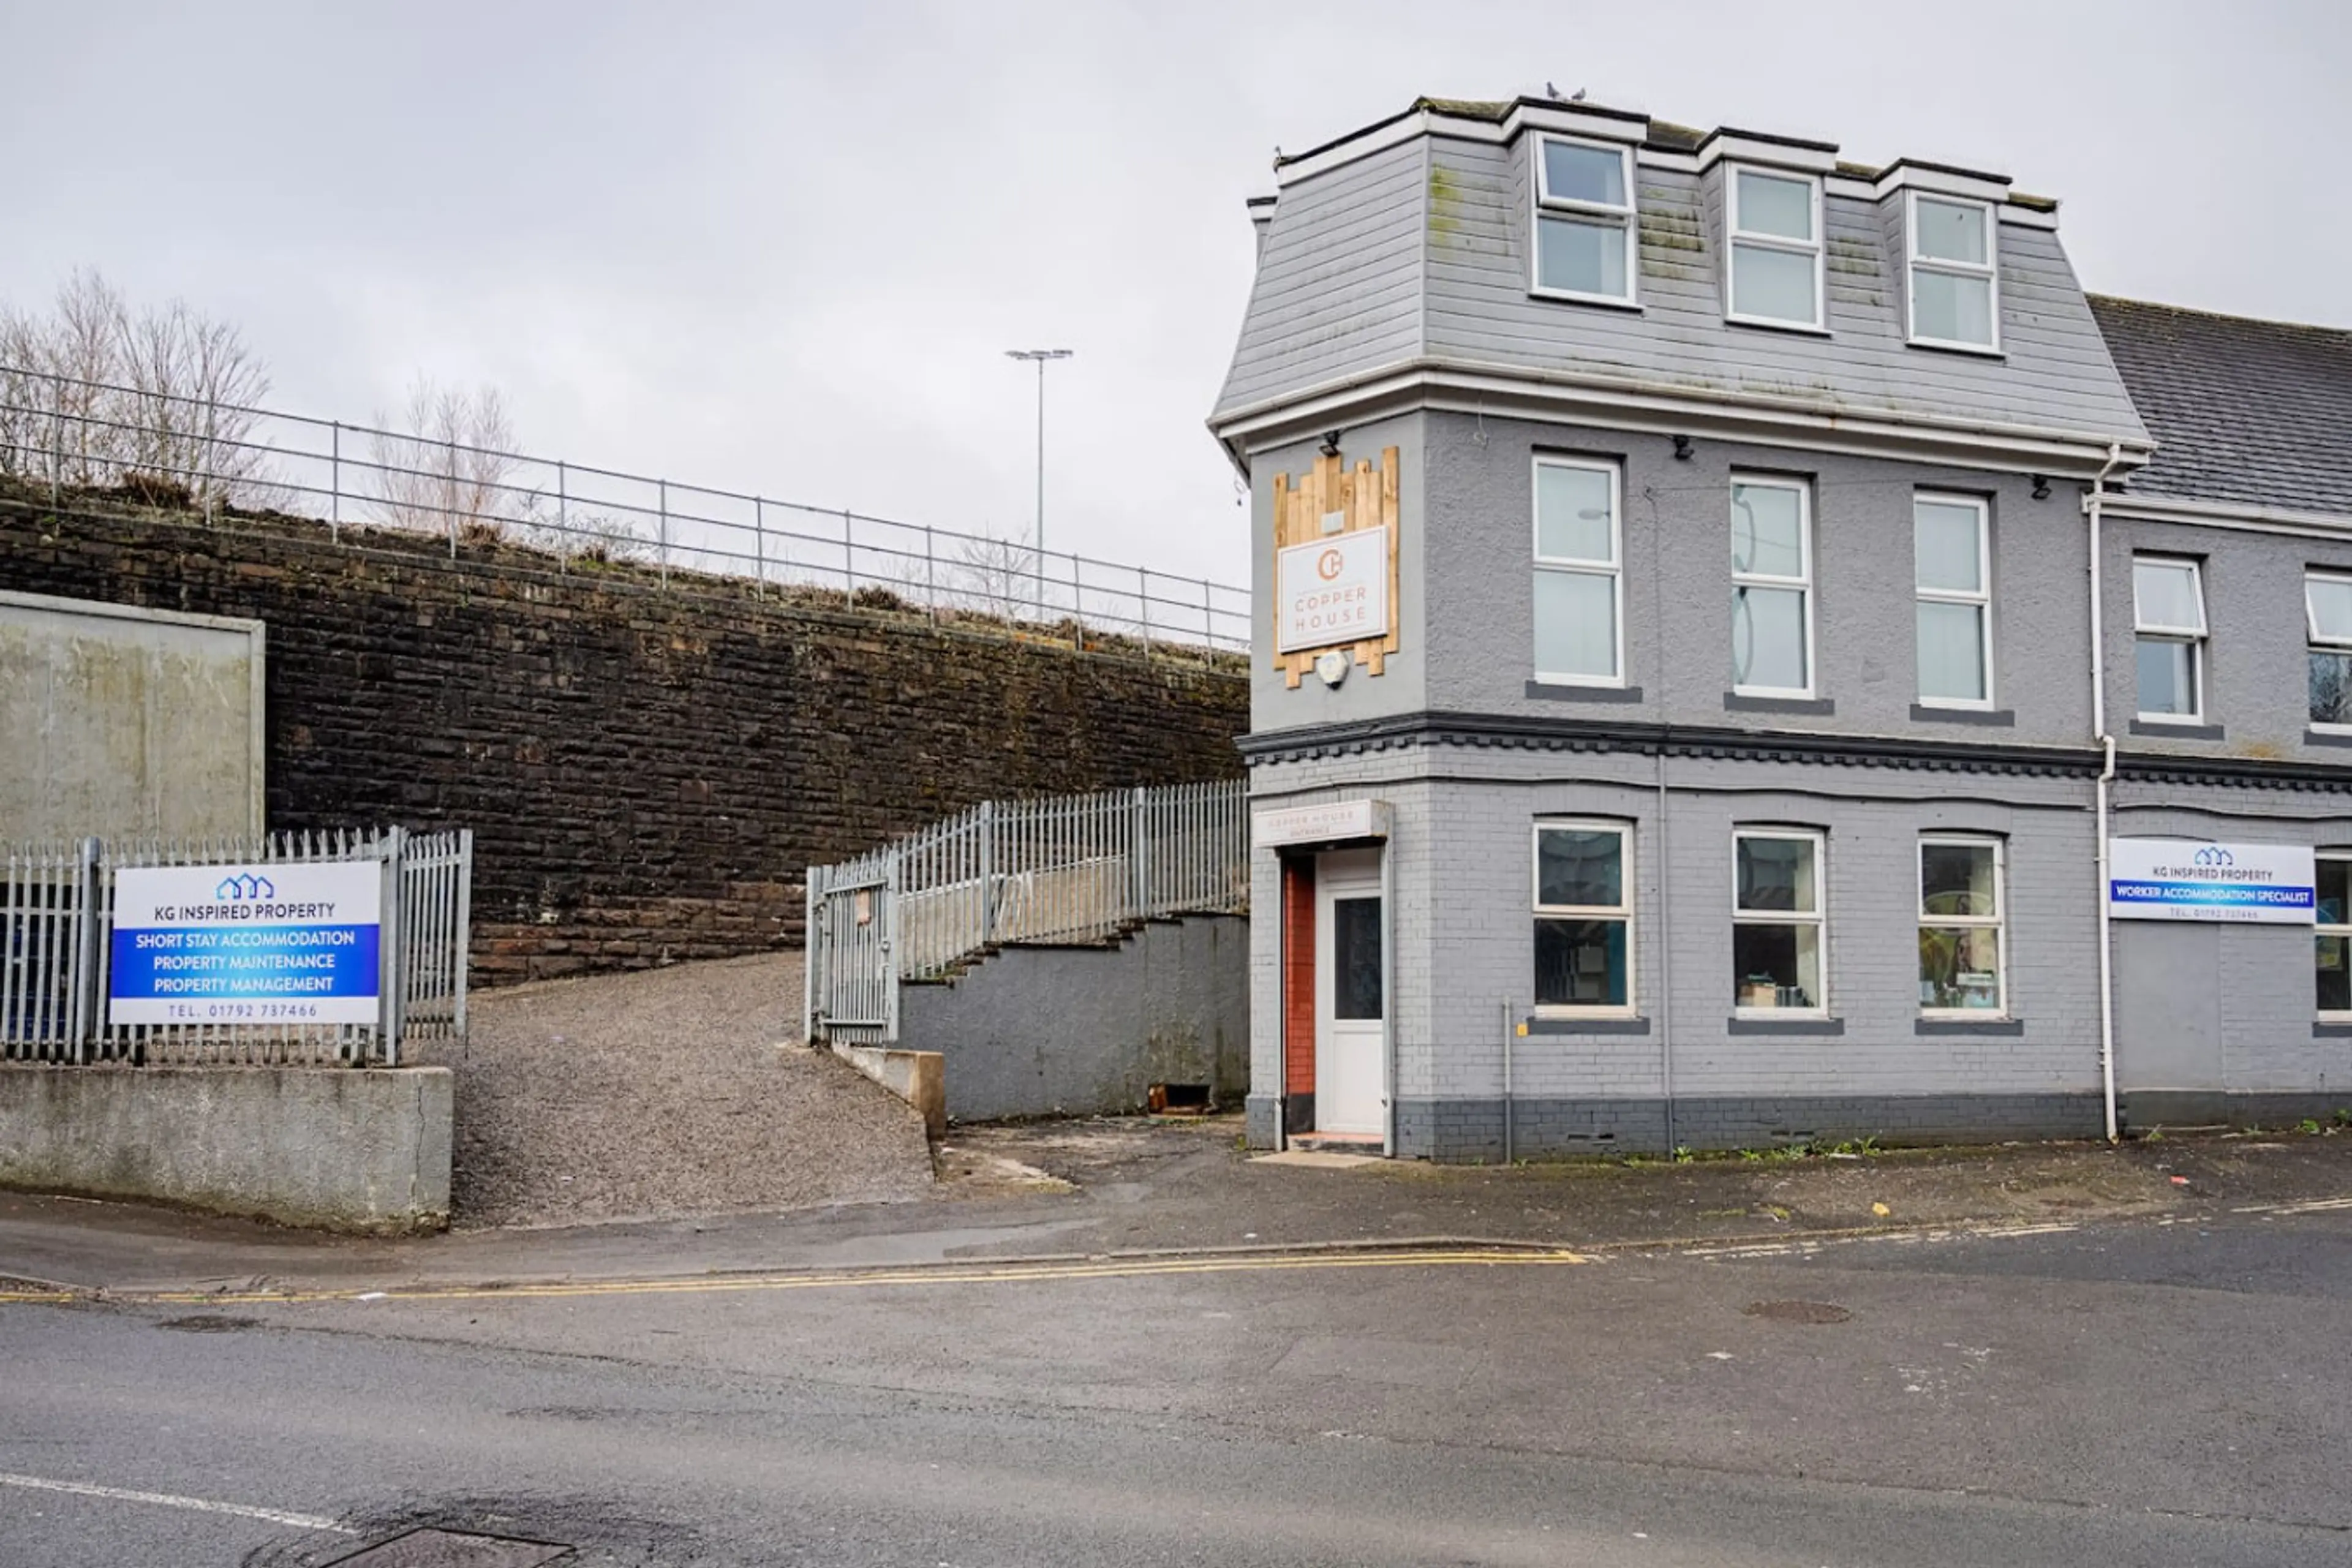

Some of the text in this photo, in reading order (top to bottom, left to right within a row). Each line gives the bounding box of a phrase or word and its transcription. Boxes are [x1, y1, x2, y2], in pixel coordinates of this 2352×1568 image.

[1294, 587, 1366, 612] COPPER
[1295, 606, 1366, 631] HOUSE
[2152, 866, 2273, 882] KG INSPIRED PROPERTY
[2116, 885, 2310, 903] WORKER ACCOMMODATION SPECIALIST
[154, 902, 336, 921] KG INSPIRED PROPERTY
[135, 930, 355, 948] SHORT STAY ACCOMMODATION
[153, 954, 336, 970] PROPERTY MAINTENANCE
[154, 976, 334, 993] PROPERTY MANAGEMENT
[169, 1005, 317, 1017] TEL. 01792 737466
